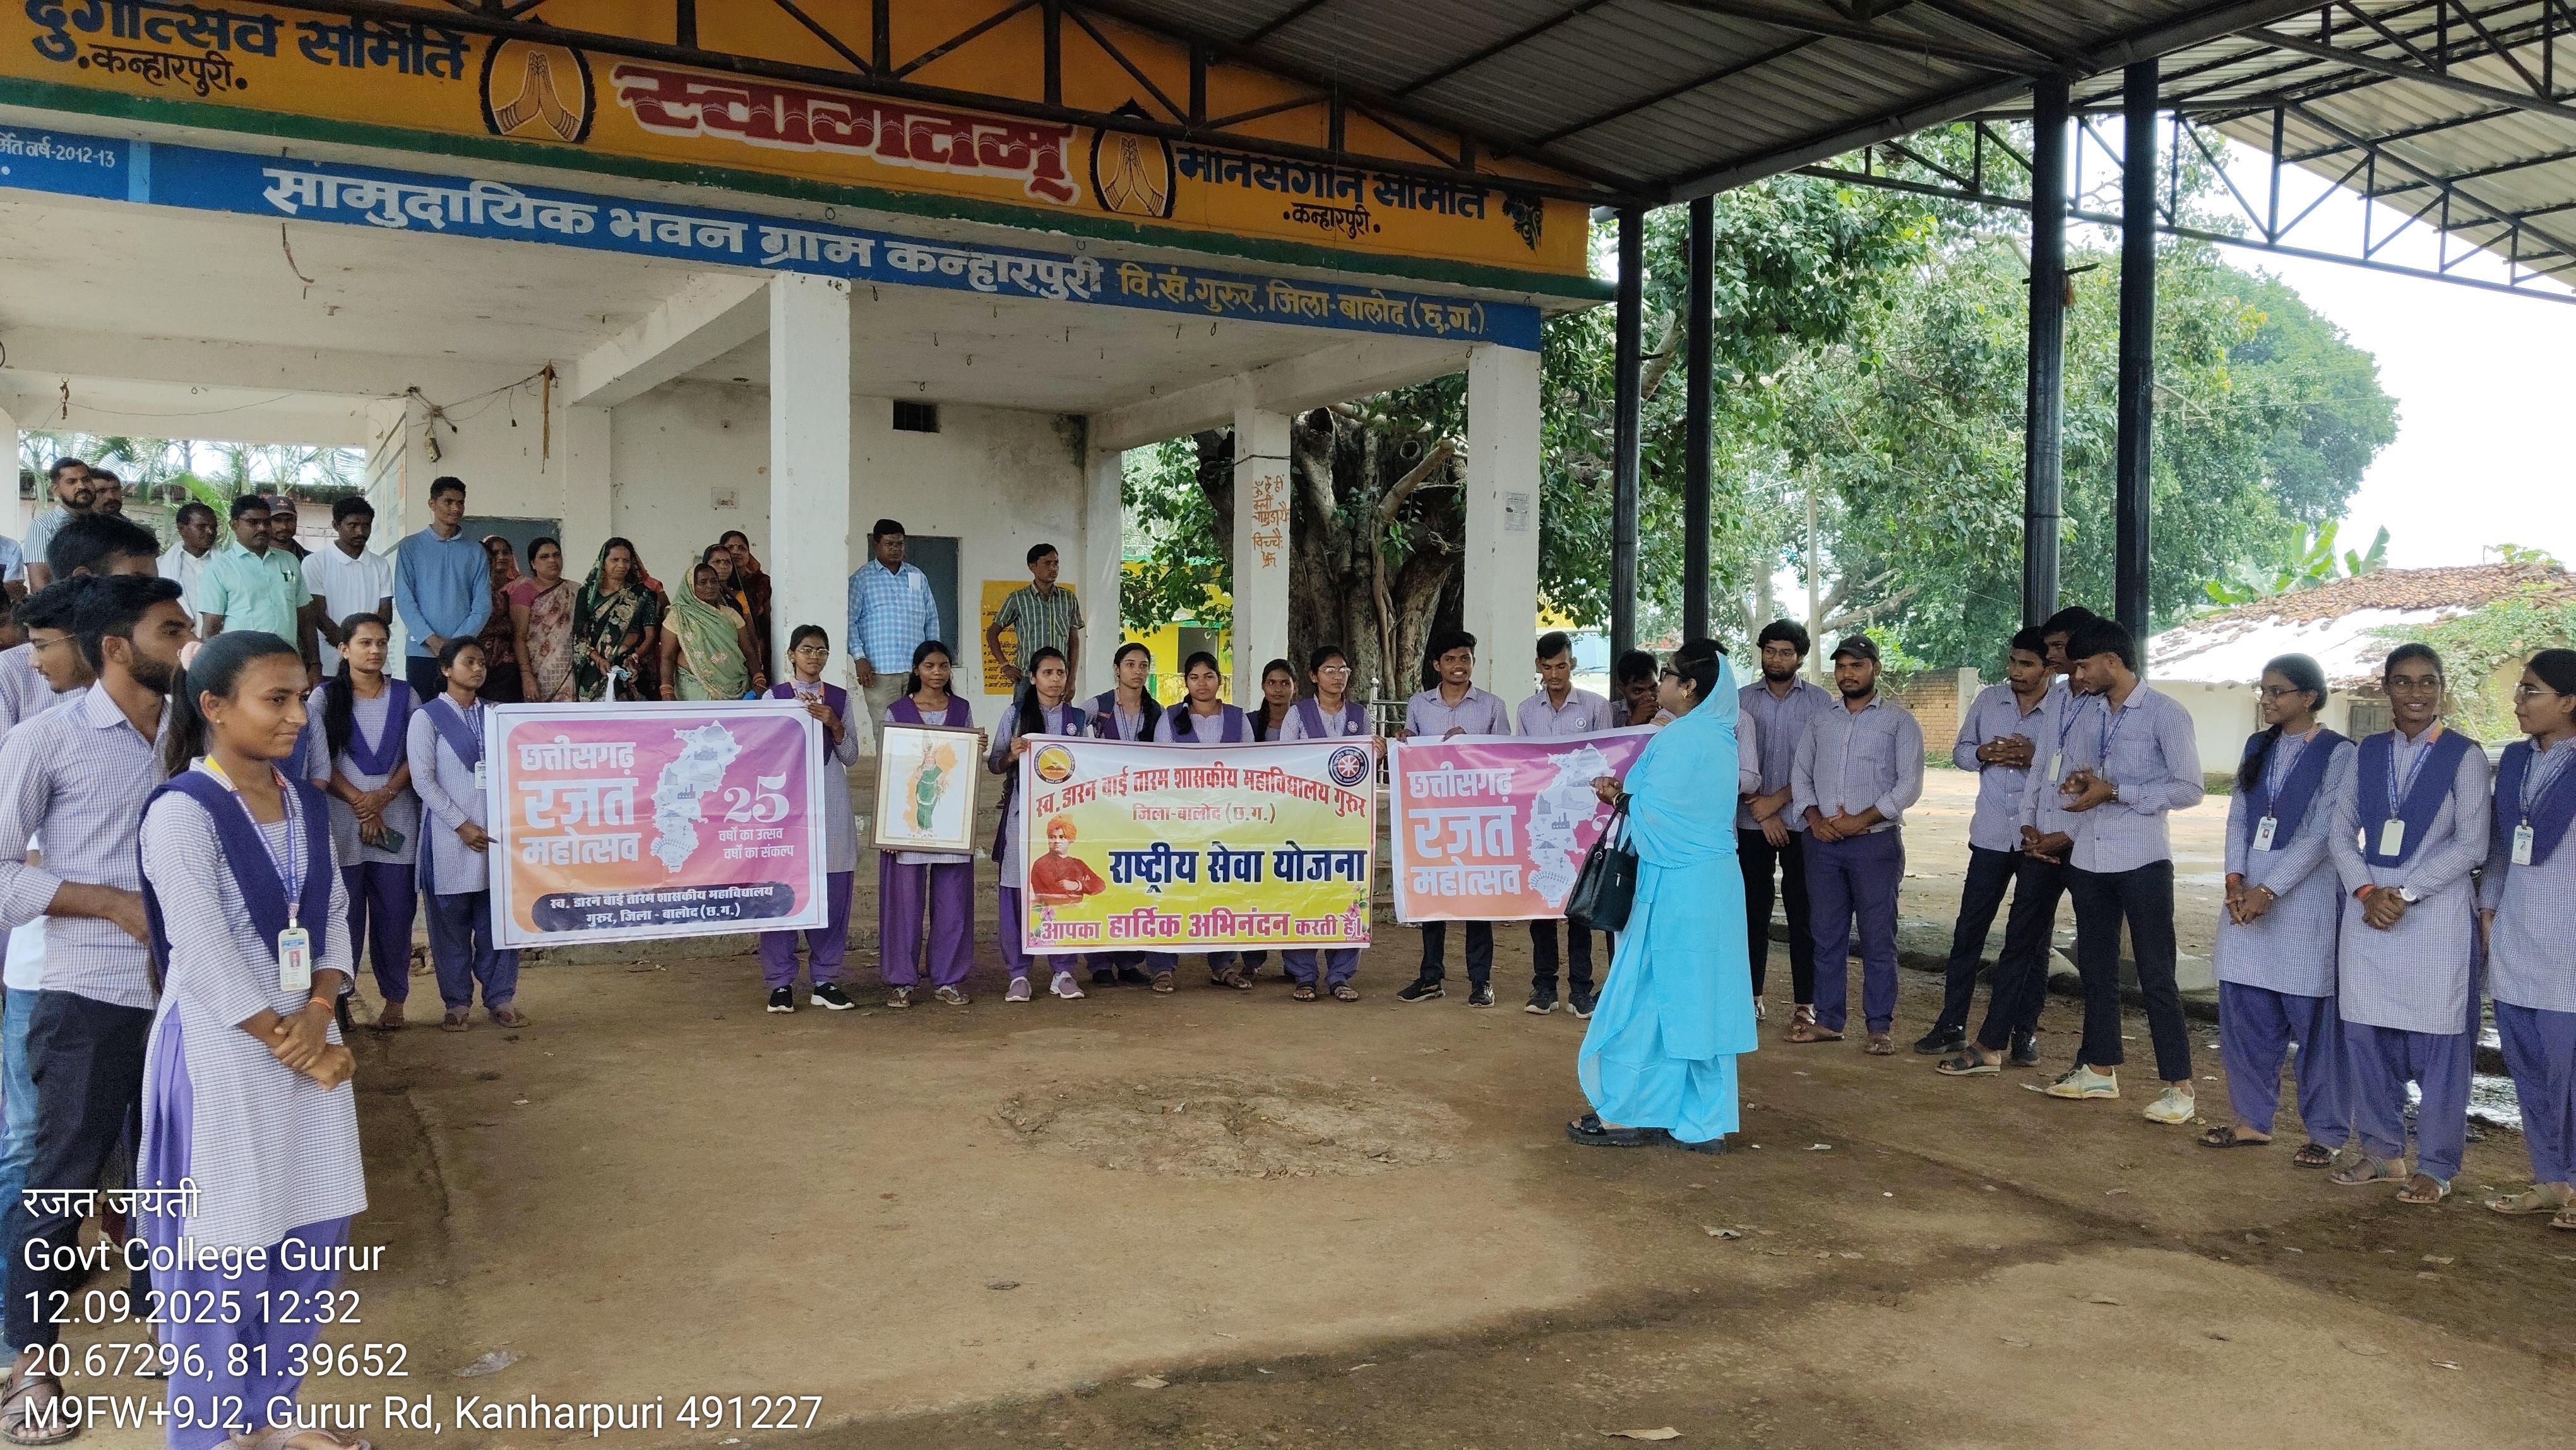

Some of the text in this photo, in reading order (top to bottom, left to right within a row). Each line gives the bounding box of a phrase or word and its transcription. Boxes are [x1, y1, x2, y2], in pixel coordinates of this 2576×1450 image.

[263, 168, 598, 235] सामुदायिक
[610, 207, 750, 253] भवन
[759, 224, 875, 269] ग्राम
[886, 242, 1104, 300] कन्हारपुरी
[518, 734, 636, 776] छत्तीसगढ़
[518, 777, 638, 829] रजत
[724, 772, 789, 823] 25
[1101, 765, 1128, 797] बाई
[1174, 761, 1239, 789] शासकीय
[1243, 765, 1330, 805] महाविद्यालय
[1407, 761, 1515, 803] छत्तीसगढ़
[519, 827, 641, 866] महोत्सव
[739, 829, 754, 841] का
[755, 828, 784, 840] उत्सव
[744, 847, 759, 858] का
[759, 844, 794, 858] संकल्प
[1409, 806, 1517, 859] रजत
[1109, 841, 1368, 894] राष्ट्रीय सेवा योजना
[1410, 857, 1522, 896] महोत्सव
[603, 892, 624, 906] बाई
[657, 889, 707, 903] शासकीय
[708, 885, 773, 900] महाविद्यालय
[620, 909, 652, 922] जिला
[662, 905, 698, 920] बालोद
[1042, 922, 1101, 939] आपका
[1108, 908, 1181, 938] हार्दिक
[1189, 908, 1291, 937] अभिनंदन
[1295, 914, 1339, 935] करती
